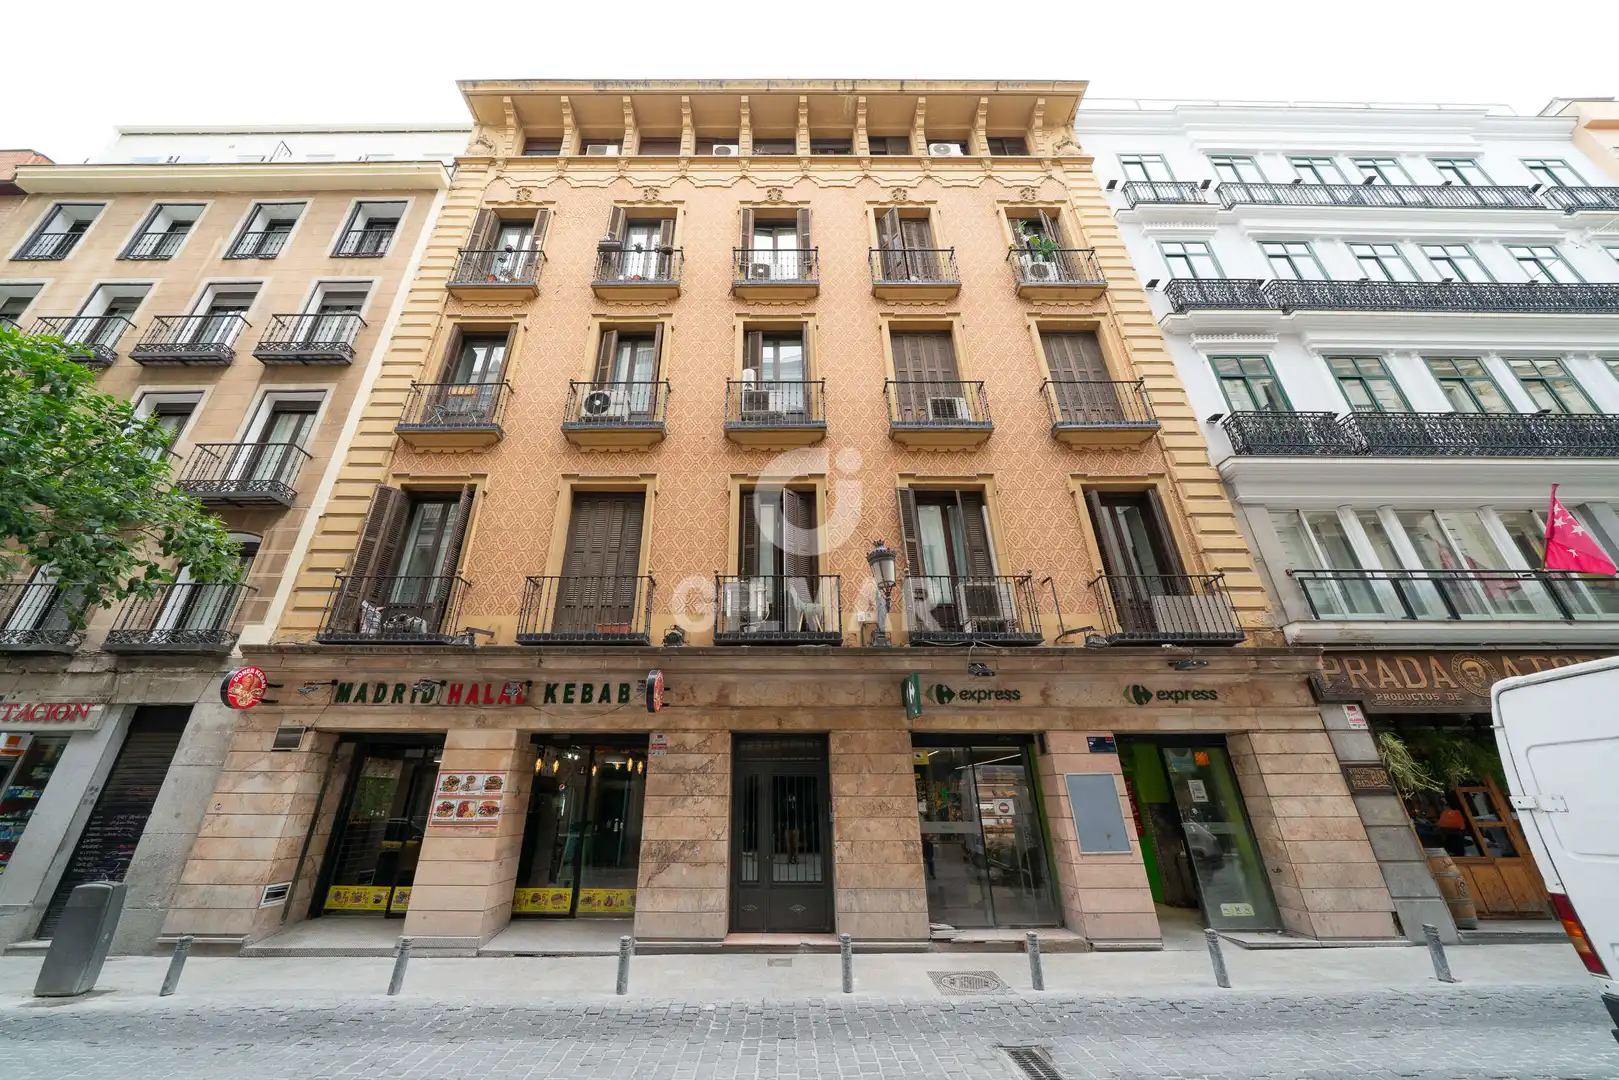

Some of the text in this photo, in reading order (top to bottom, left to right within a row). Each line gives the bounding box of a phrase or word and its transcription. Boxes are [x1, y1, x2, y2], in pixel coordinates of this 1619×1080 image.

[255, 669, 267, 689] KEBAB
[1319, 654, 1460, 689] PRADA
[334, 682, 436, 704] MADRID
[543, 682, 631, 704] KEBAB
[959, 688, 1022, 704] express
[1156, 689, 1219, 704] express
[1375, 692, 1463, 700] PRODUCTOS DE
[0, 703, 93, 721] TACION
